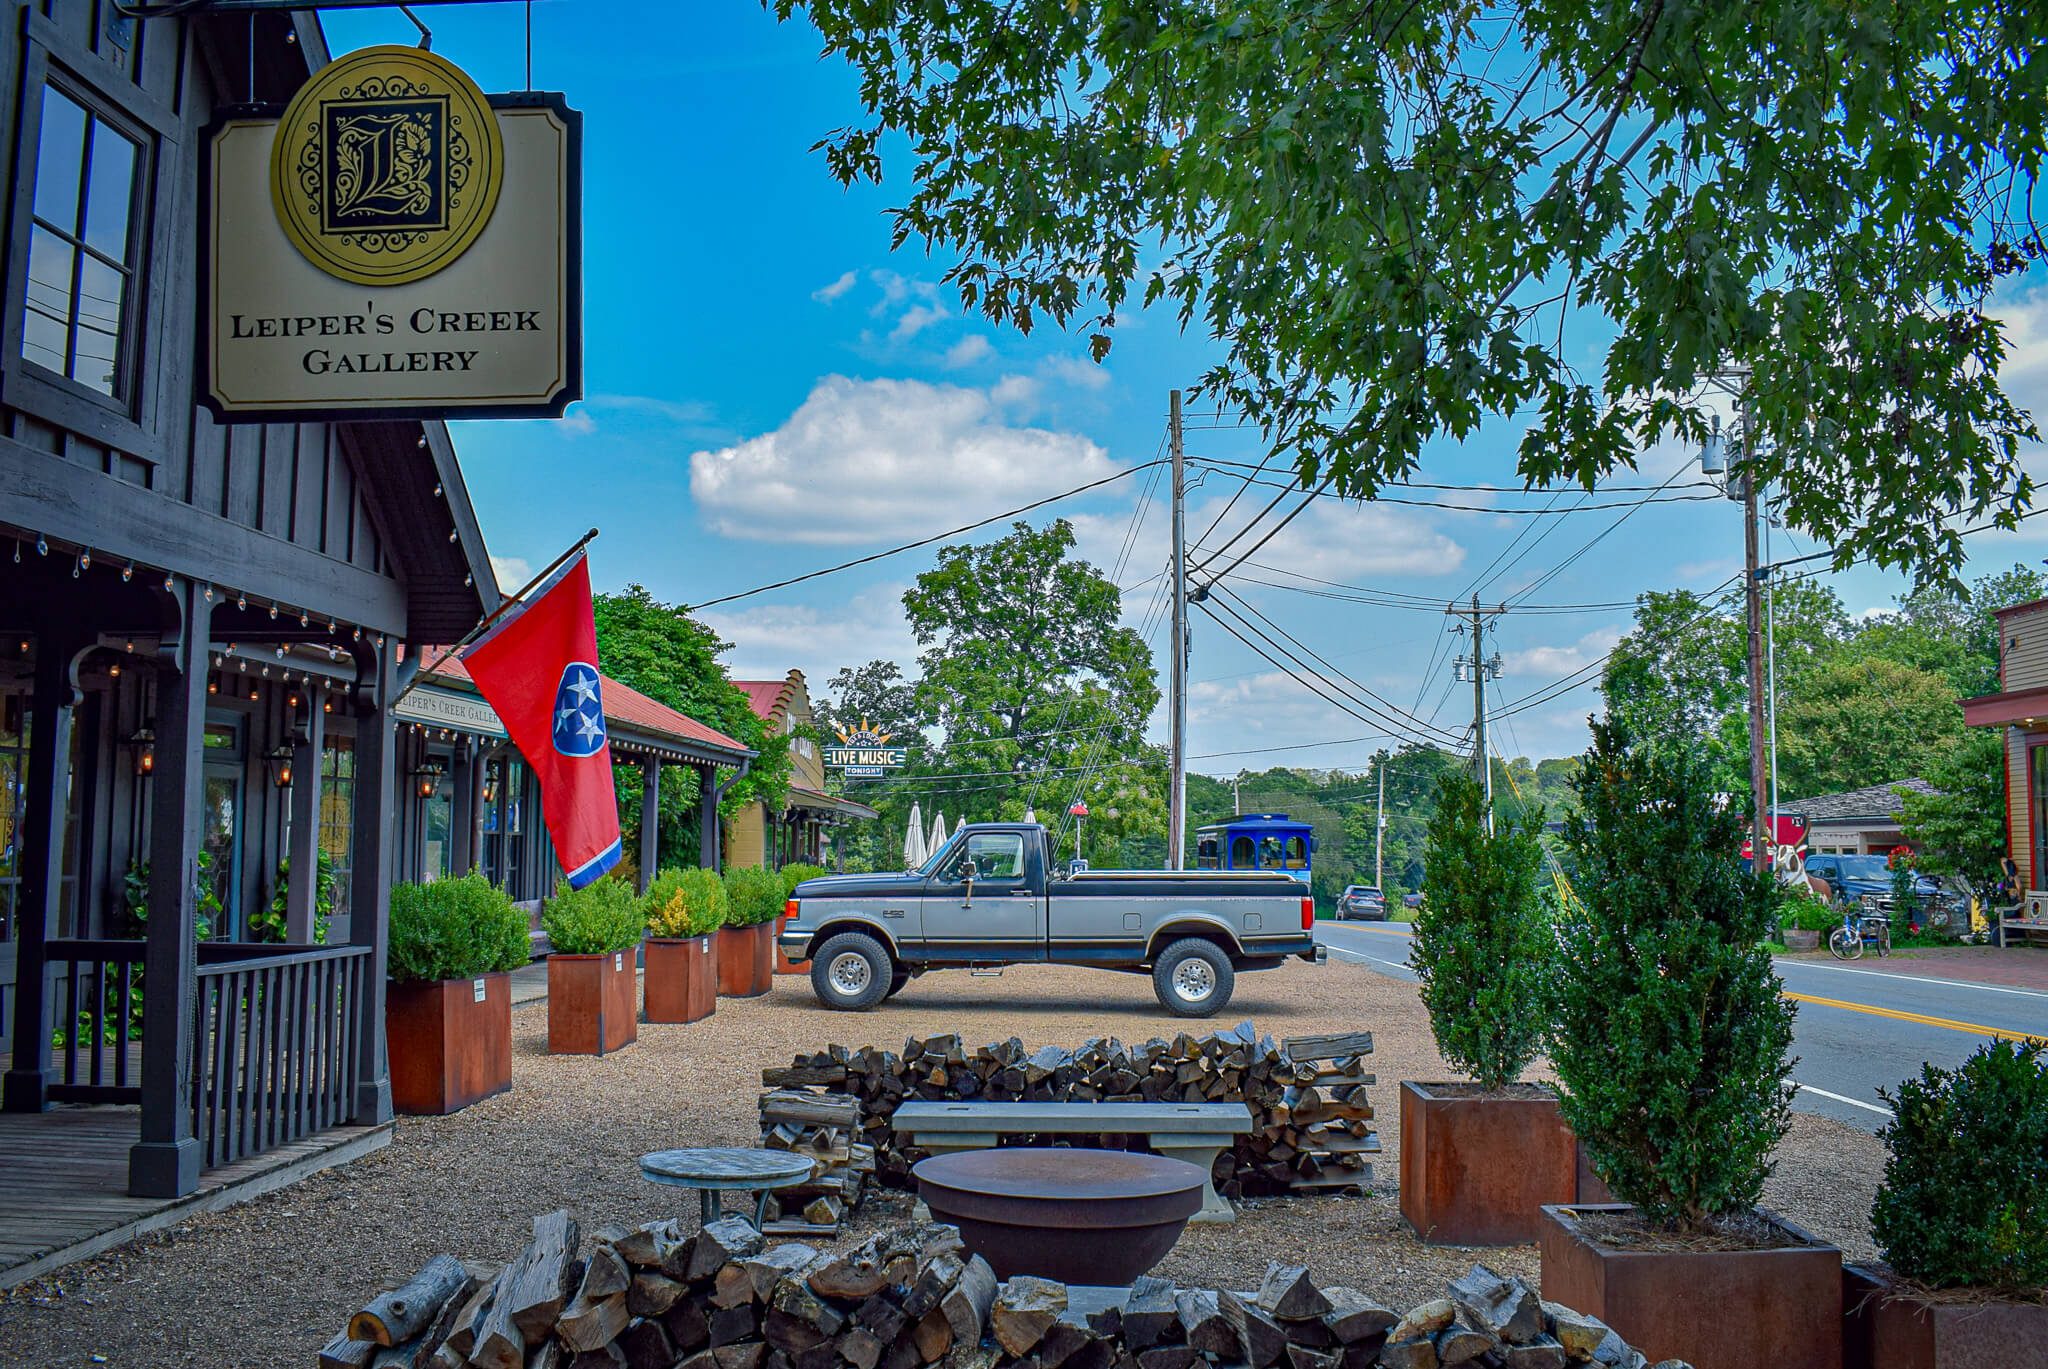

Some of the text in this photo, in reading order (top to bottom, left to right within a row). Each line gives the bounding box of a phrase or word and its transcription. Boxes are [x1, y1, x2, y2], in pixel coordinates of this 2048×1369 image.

[231, 301, 541, 339] LEIPER'S CREEK
[302, 349, 479, 375] GALLERY
[439, 700, 467, 717] CREEK
[468, 707, 501, 724] GALLER
[832, 751, 896, 765] LIVE MUSIC
